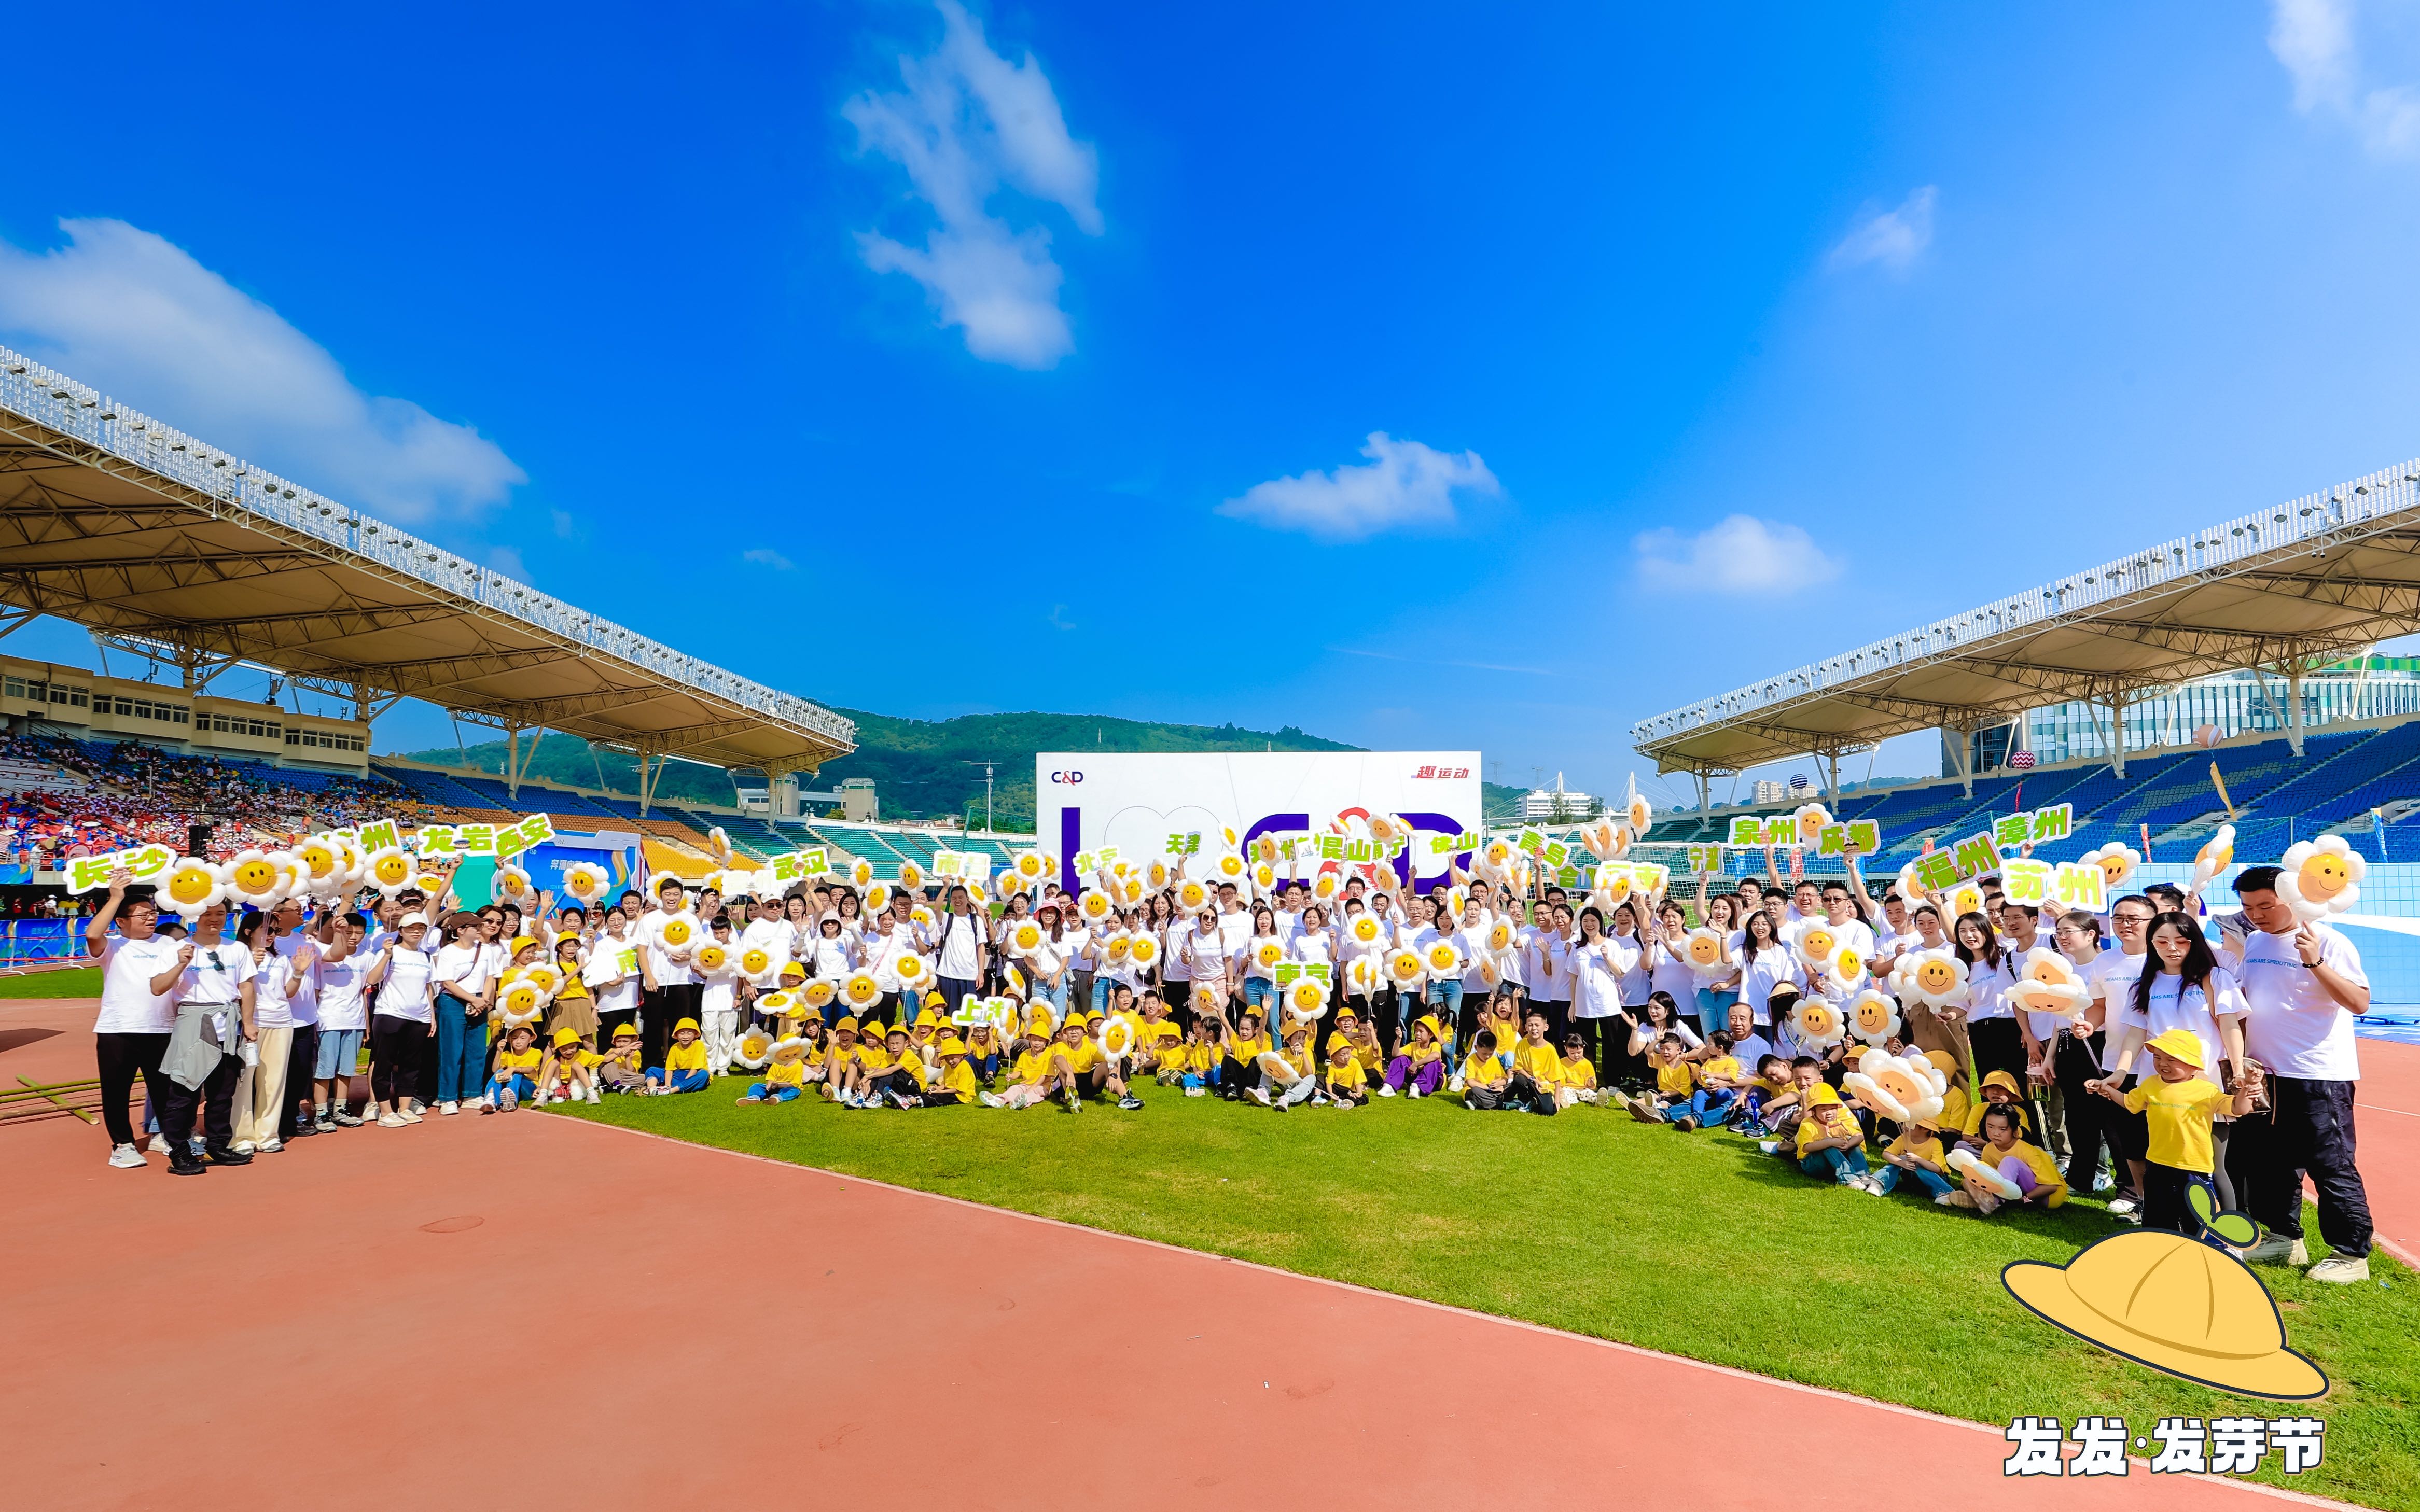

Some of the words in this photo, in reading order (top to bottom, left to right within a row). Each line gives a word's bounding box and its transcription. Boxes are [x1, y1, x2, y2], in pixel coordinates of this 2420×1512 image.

[1051, 771, 1083, 786] C&D
[1416, 766, 1469, 778] 趣运动
[422, 825, 493, 853] 龙岩
[496, 816, 553, 856] 西安
[1733, 819, 1796, 845] 泉州
[1819, 823, 1876, 855] 成都
[1996, 806, 2069, 847] 漳州
[1166, 834, 1201, 855] 天津
[1322, 836, 1370, 862] 昆山
[1430, 831, 1479, 854] 佛山
[1518, 829, 1568, 867] 青岛
[71, 847, 169, 889] 长沙
[773, 850, 829, 880] 武汉
[1076, 848, 1117, 874] 北京
[1689, 845, 1720, 871] 宁波
[1916, 835, 2000, 891] 福州
[2007, 863, 2102, 905] 苏州
[1274, 963, 1330, 988] 南京
